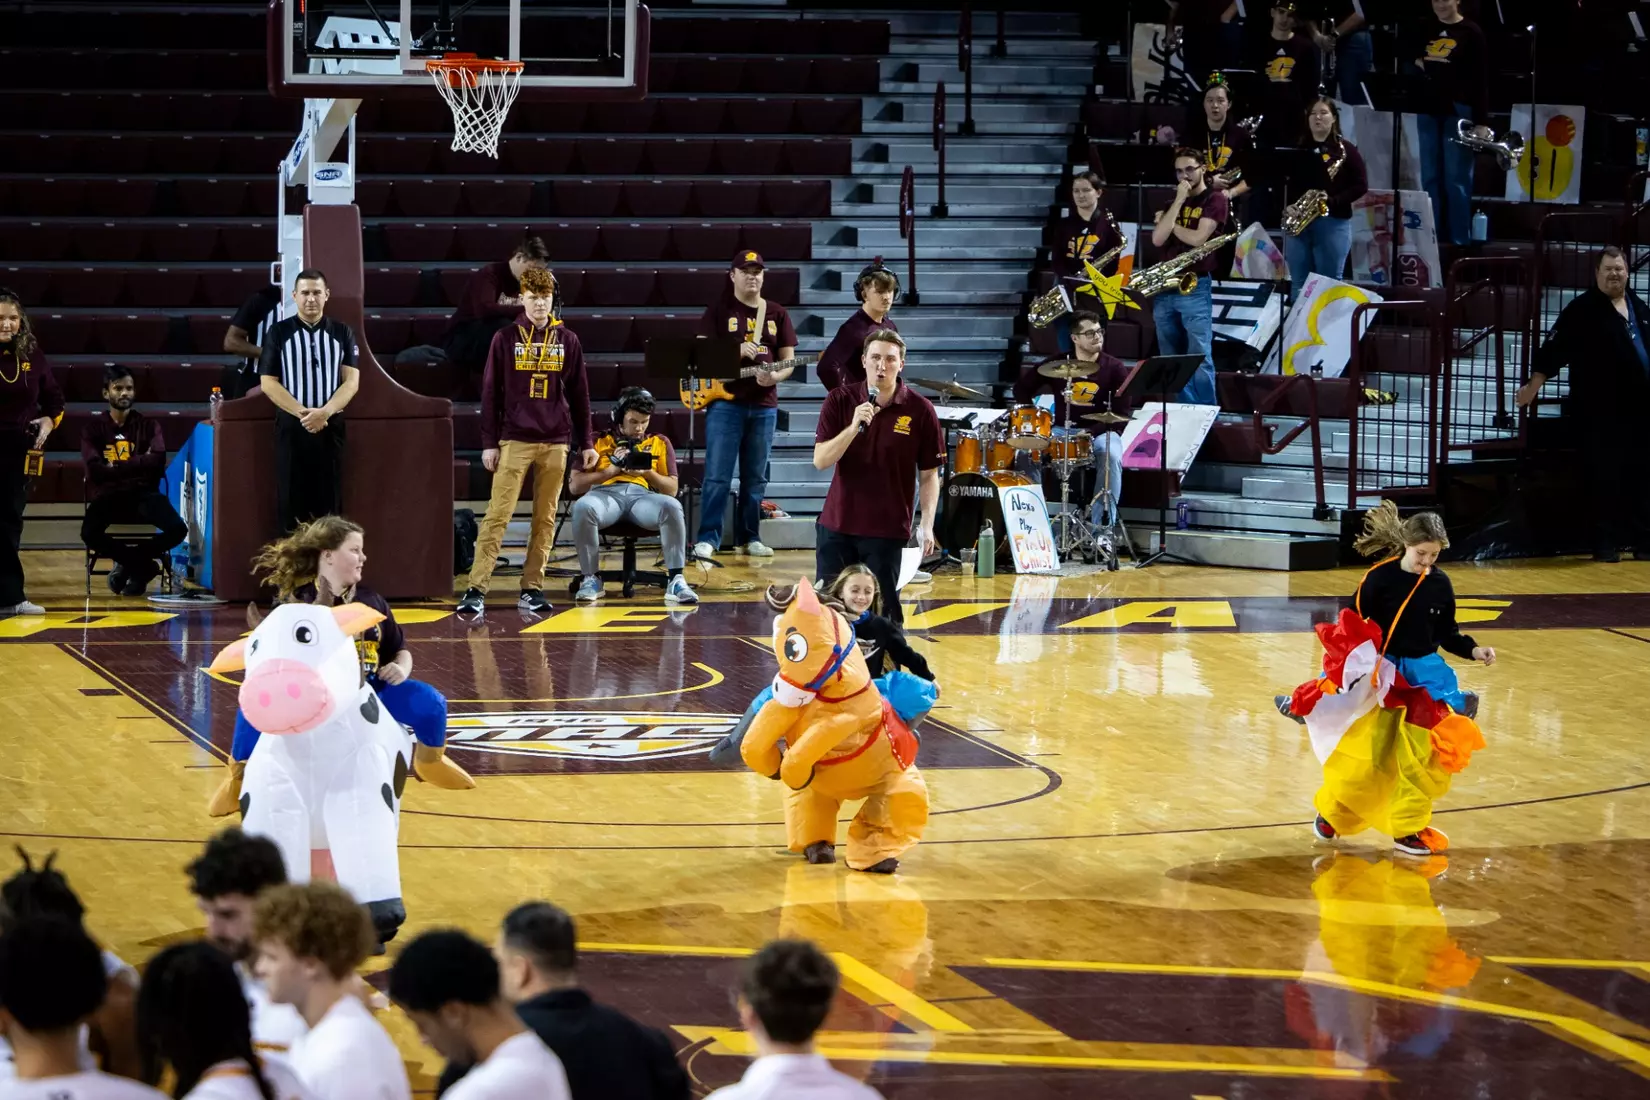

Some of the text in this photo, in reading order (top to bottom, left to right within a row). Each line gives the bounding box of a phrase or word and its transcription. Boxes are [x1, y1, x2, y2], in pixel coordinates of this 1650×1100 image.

[1401, 256, 1419, 287] STO
[1094, 274, 1124, 298] you trie
[959, 486, 994, 498] YAMAHA
[1011, 493, 1035, 512] Alexa
[508, 717, 607, 725] 1946
